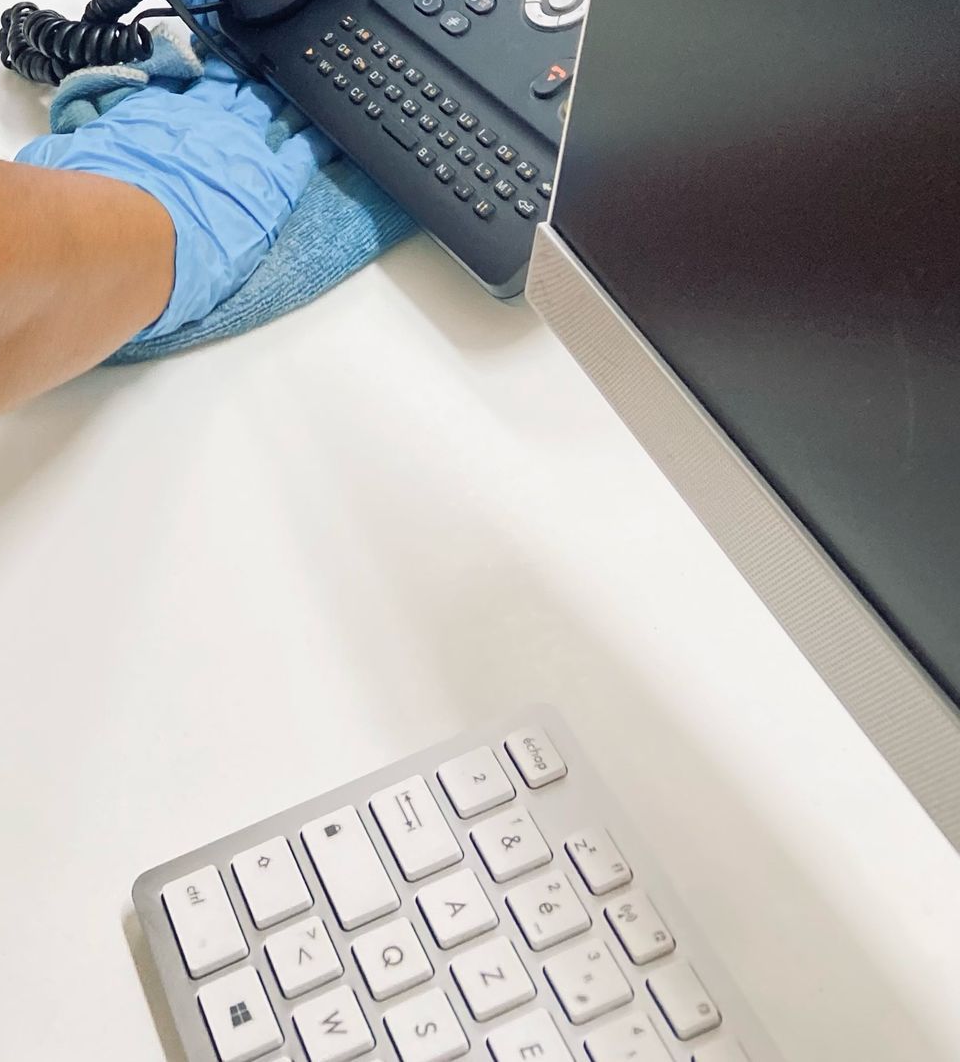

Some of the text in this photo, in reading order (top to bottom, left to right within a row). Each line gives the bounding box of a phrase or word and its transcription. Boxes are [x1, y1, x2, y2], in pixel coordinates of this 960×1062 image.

[373, 41, 382, 50] Z
[353, 57, 362, 65] S
[389, 54, 398, 63] E
[320, 59, 329, 70] W
[369, 70, 379, 79] D
[406, 68, 415, 77] R
[334, 73, 344, 82] X
[385, 84, 395, 92] F
[424, 82, 432, 91] T
[350, 88, 359, 96] C
[367, 101, 376, 110] V
[403, 99, 413, 108] G
[442, 97, 451, 106] Y
[420, 114, 430, 123] H
[459, 113, 469, 122] U
[439, 130, 449, 138] J
[418, 148, 427, 157] B
[457, 145, 467, 155] K
[436, 164, 447, 174] N
[476, 162, 484, 172] L
[495, 180, 508, 191] M
[501, 834, 522, 851] &
[547, 881, 561, 892] 2
[186, 884, 207, 906] ctrl
[444, 899, 468, 918] A
[539, 901, 561, 915] é
[381, 945, 404, 969] Q
[587, 951, 601, 963] 3
[480, 966, 506, 987] Z
[320, 1009, 349, 1037] W
[415, 1021, 438, 1038] S
[520, 1042, 545, 1060] E
